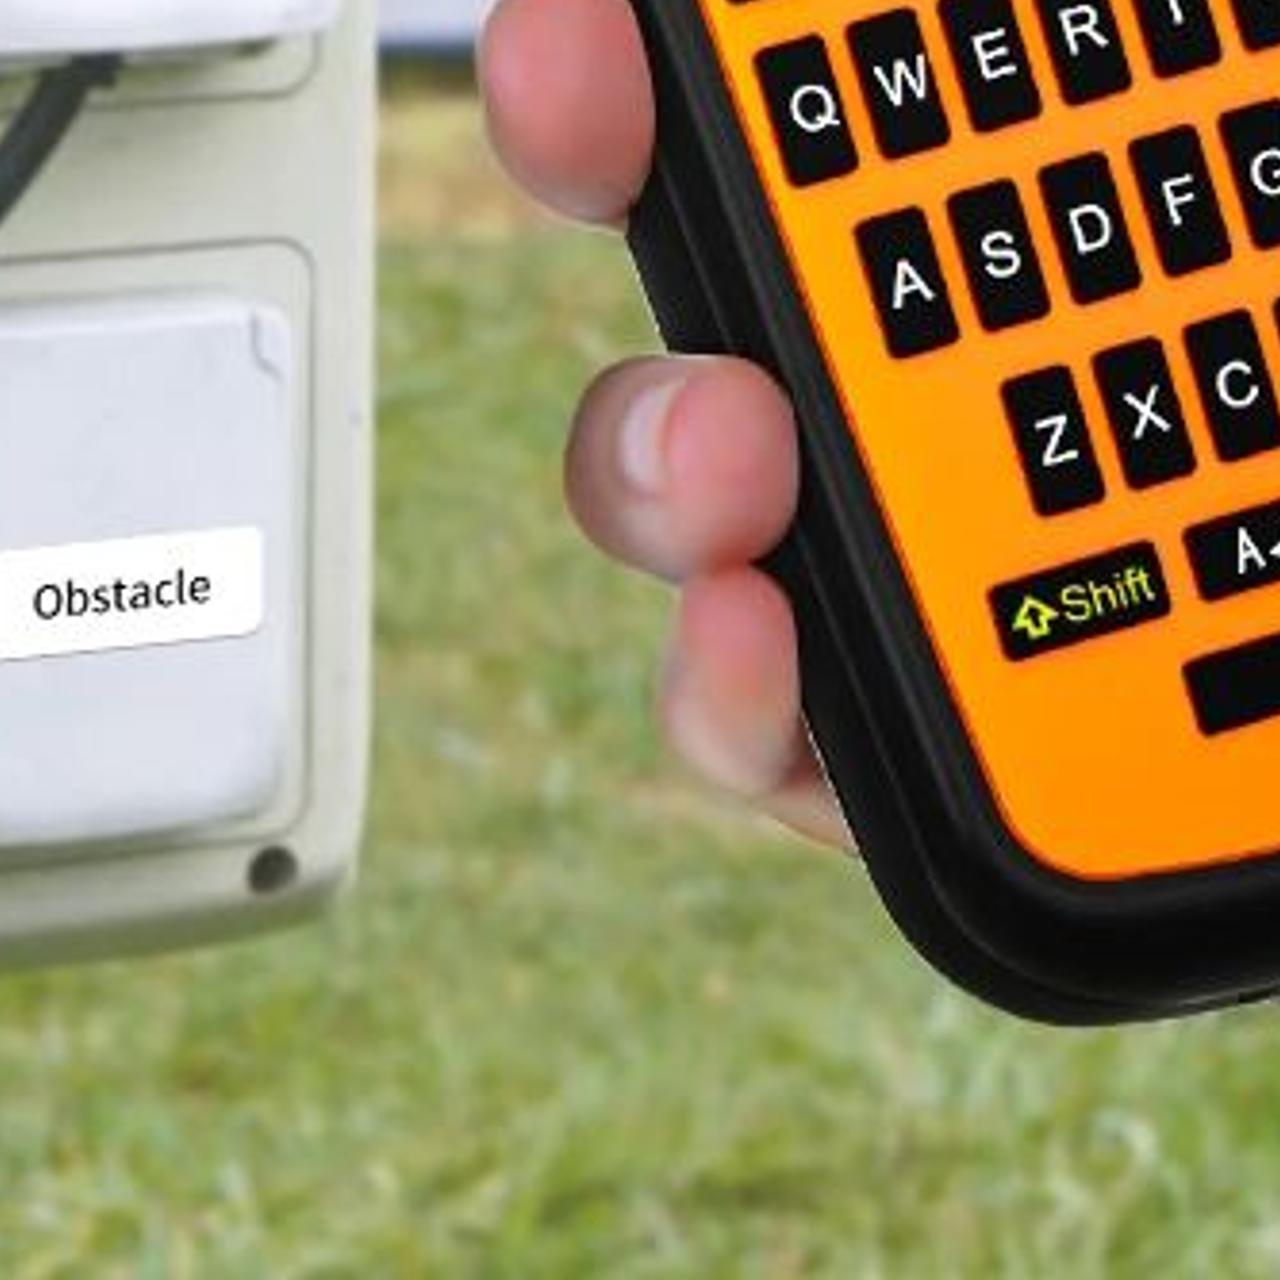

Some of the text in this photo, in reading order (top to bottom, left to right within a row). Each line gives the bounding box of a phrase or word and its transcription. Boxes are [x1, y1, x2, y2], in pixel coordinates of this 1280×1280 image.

[970, 26, 1018, 82] E
[1057, 3, 1110, 57] R
[872, 53, 927, 108] W
[788, 83, 842, 134] Q
[1160, 172, 1196, 227] F
[979, 229, 1022, 280] S
[1067, 202, 1113, 256] D
[891, 258, 936, 311] A
[1122, 383, 1172, 440] X
[1214, 359, 1260, 409] C
[1033, 413, 1080, 468] Z
[32, 567, 212, 622] Obstacle
[1059, 566, 1156, 623] Shift
